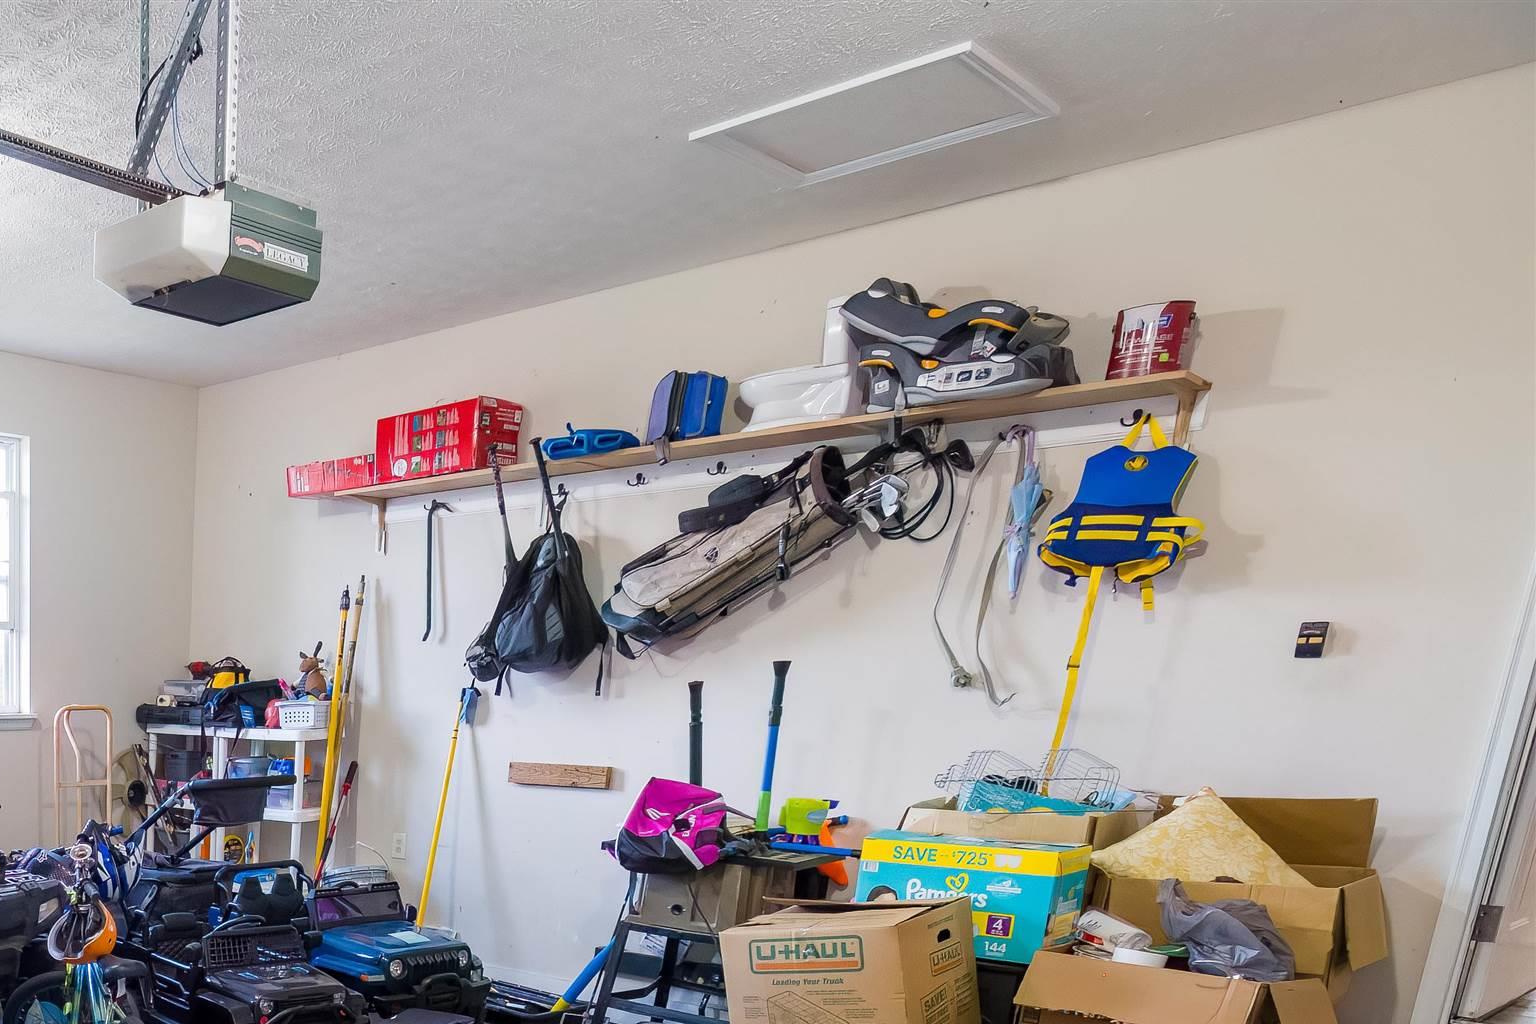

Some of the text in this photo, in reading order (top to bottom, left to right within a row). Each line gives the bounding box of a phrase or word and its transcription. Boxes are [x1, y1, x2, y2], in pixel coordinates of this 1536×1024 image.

[266, 247, 306, 268] LEGACY
[893, 846, 938, 862] SAVE
[993, 919, 1003, 931] 4
[756, 942, 856, 961] U-HAUL
[984, 941, 1007, 953] 144
[772, 978, 801, 987] Loading
[823, 977, 844, 985] Truck
